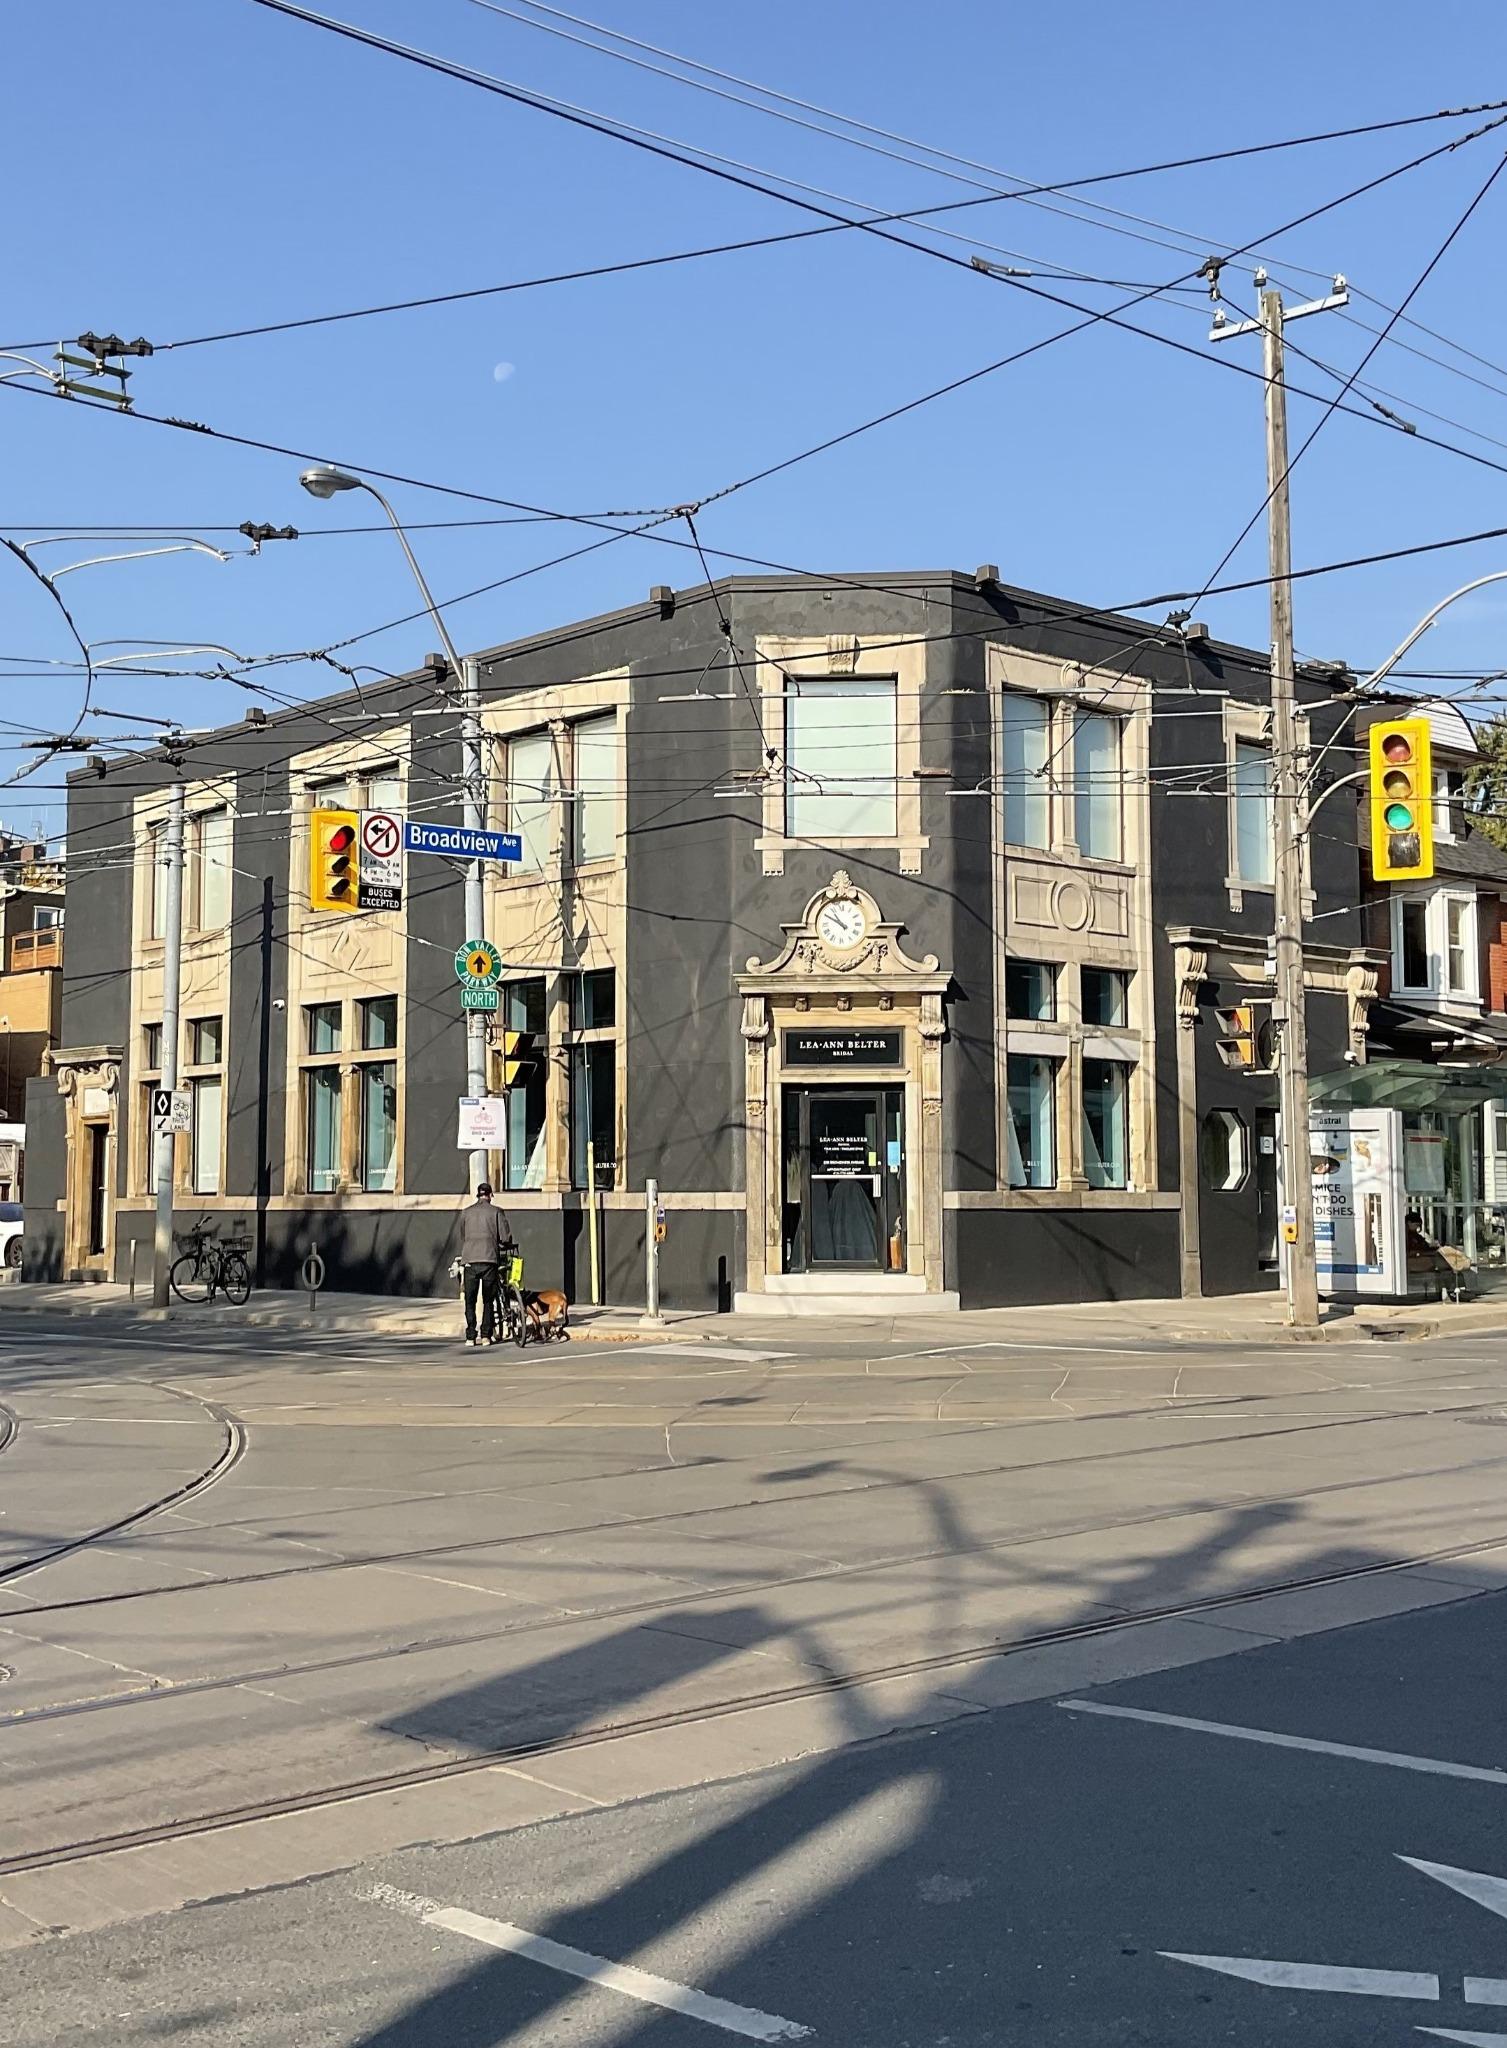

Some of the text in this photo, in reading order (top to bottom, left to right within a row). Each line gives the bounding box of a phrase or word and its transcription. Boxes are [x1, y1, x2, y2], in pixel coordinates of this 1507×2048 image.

[410, 826, 517, 853] Broadview Ave
[363, 856, 368, 865] 7
[386, 859, 391, 867] 9
[363, 866, 368, 875] 4
[387, 869, 392, 878] 6
[368, 887, 394, 898] BUSES
[361, 896, 400, 909] EXCEPTED
[457, 945, 472, 961] DON
[475, 940, 501, 963] VALLEY
[460, 970, 498, 988] PARKWAY
[464, 991, 496, 1007] NORTH
[848, 1040, 887, 1049] BELTER
[1319, 1117, 1342, 1125] astral
[1315, 1184, 1341, 1193] MICE
[1330, 1195, 1347, 1205] DO
